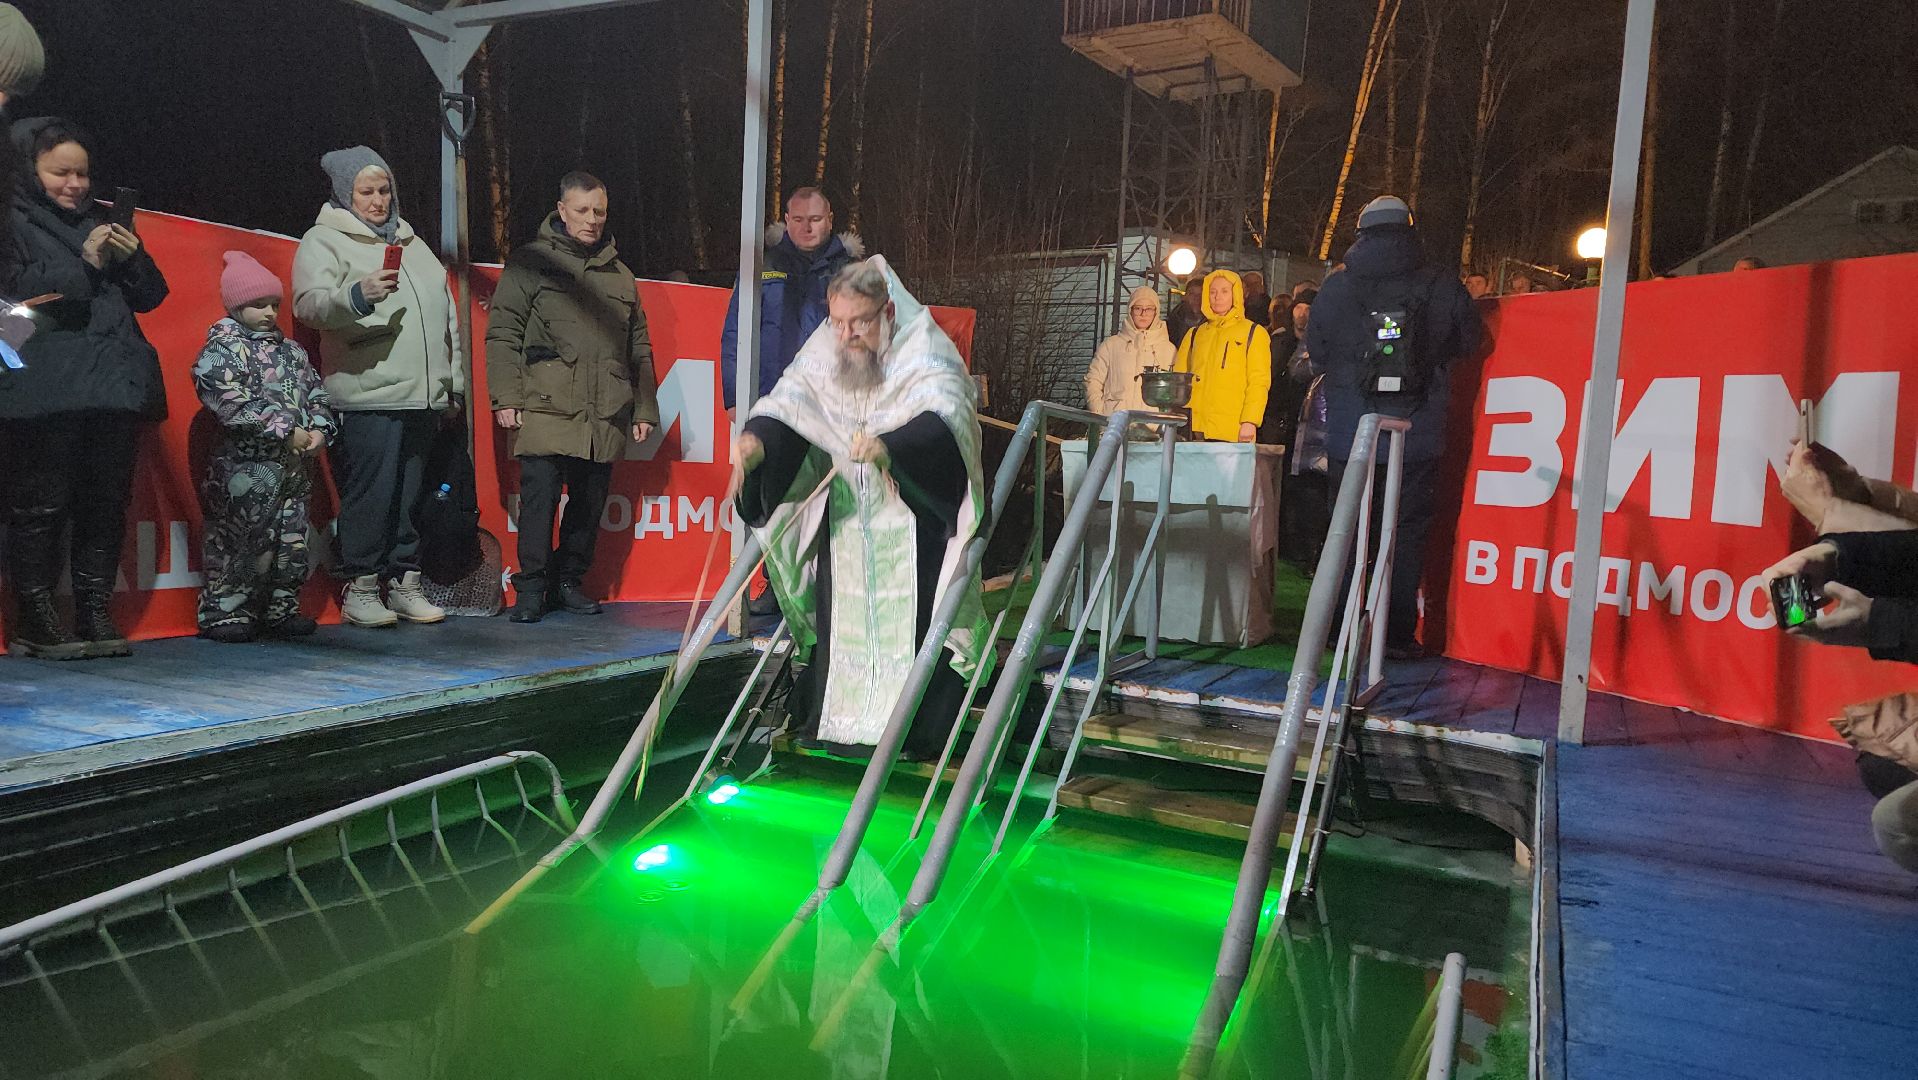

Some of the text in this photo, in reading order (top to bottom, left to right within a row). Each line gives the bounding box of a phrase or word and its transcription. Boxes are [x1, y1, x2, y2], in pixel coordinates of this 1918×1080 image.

[1474, 371, 1918, 528] ЗИМ
[1465, 539, 1779, 631] В ПОДМОС
